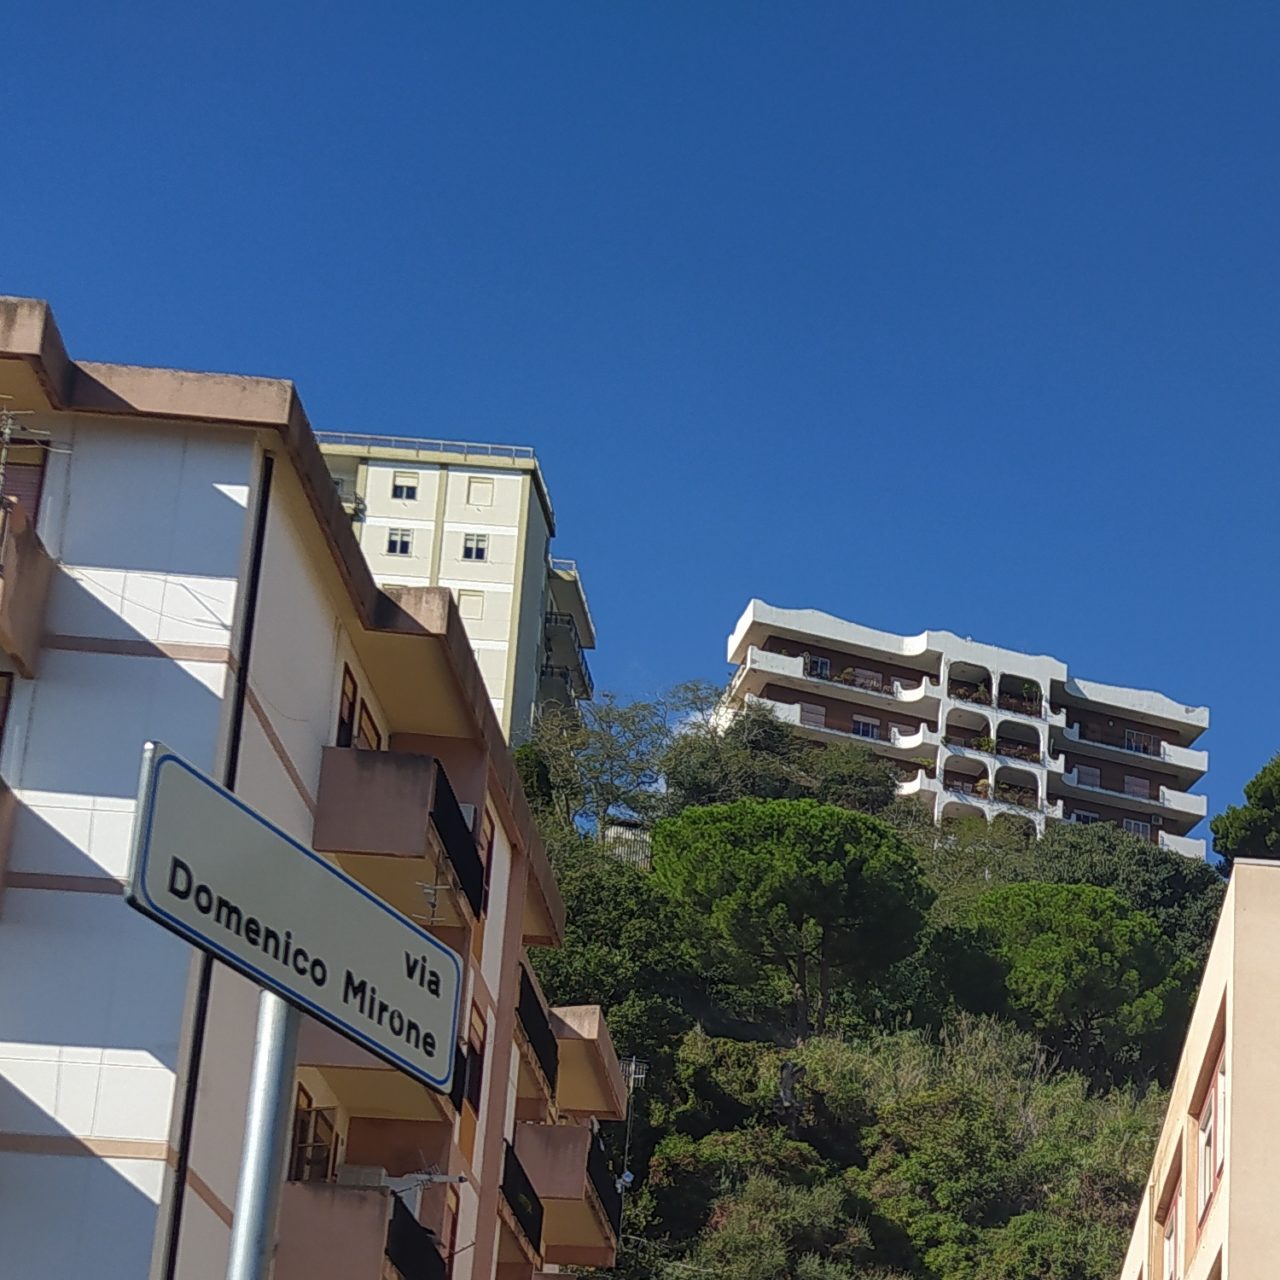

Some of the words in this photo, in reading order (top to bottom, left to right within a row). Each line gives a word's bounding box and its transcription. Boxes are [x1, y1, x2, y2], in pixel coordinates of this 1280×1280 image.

[167, 855, 327, 988] Domenico
[342, 968, 437, 1058] Mirone
[404, 950, 441, 999] via
